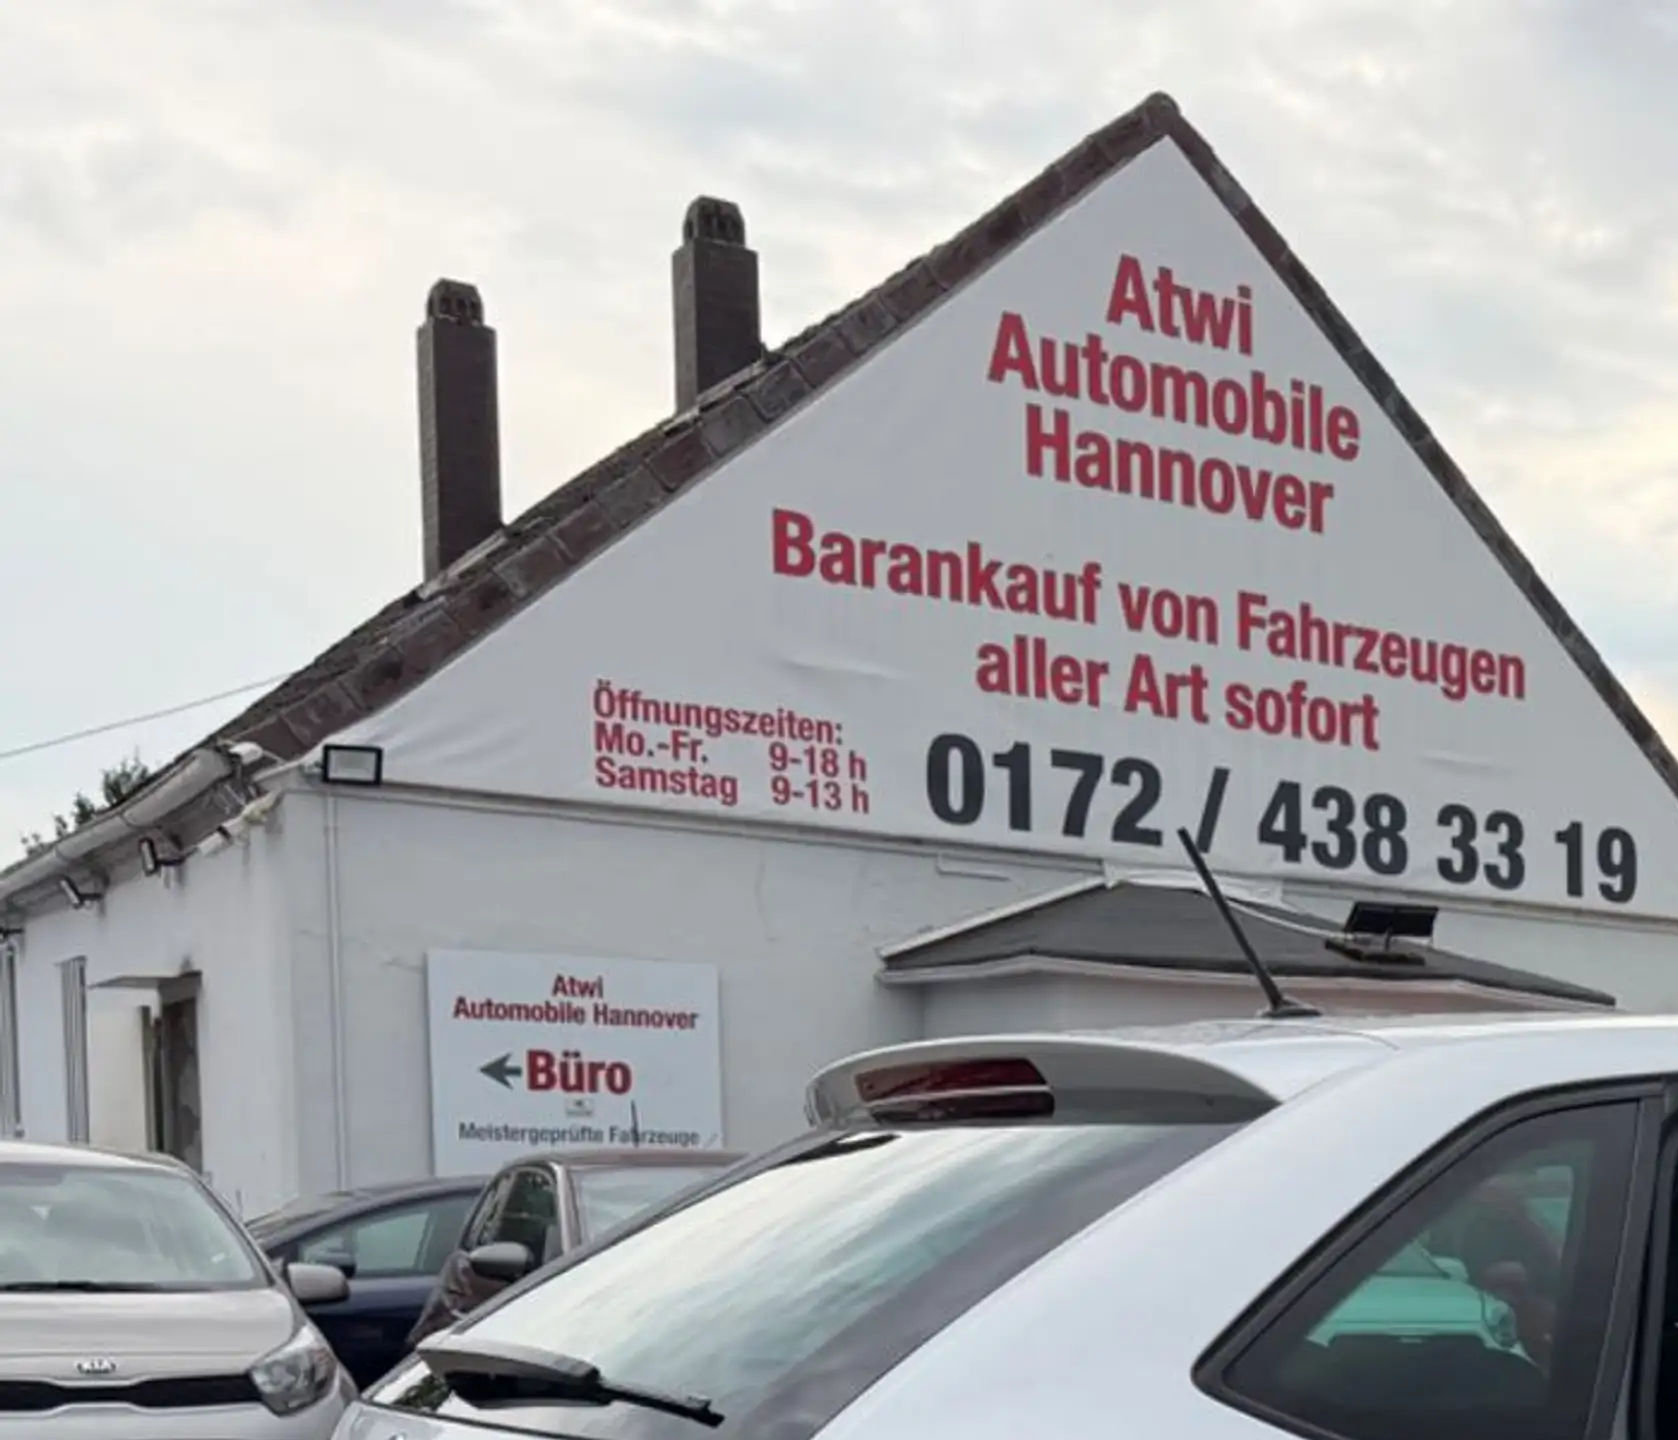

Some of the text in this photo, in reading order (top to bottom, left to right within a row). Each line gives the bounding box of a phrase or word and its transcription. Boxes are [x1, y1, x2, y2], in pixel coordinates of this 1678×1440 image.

[1106, 255, 1254, 356] Atwi
[986, 311, 1362, 462] Automobile
[1024, 402, 1336, 535] Hannover
[770, 508, 1528, 702] Barankauf von Fahrzeugen
[593, 678, 844, 746] Öffnungszeiten:
[975, 635, 1380, 752] aller Art sofort
[593, 721, 867, 782] Mo.-Fr. 9-18 h
[593, 755, 870, 814] Samstag 9-13 h
[926, 733, 1640, 904] 0172 / 438 33 19
[453, 996, 699, 1030] Automobile Hannover
[551, 974, 604, 998] Atwi
[526, 1048, 633, 1096] Büro
[459, 1121, 604, 1146] Meistergeprüfte
